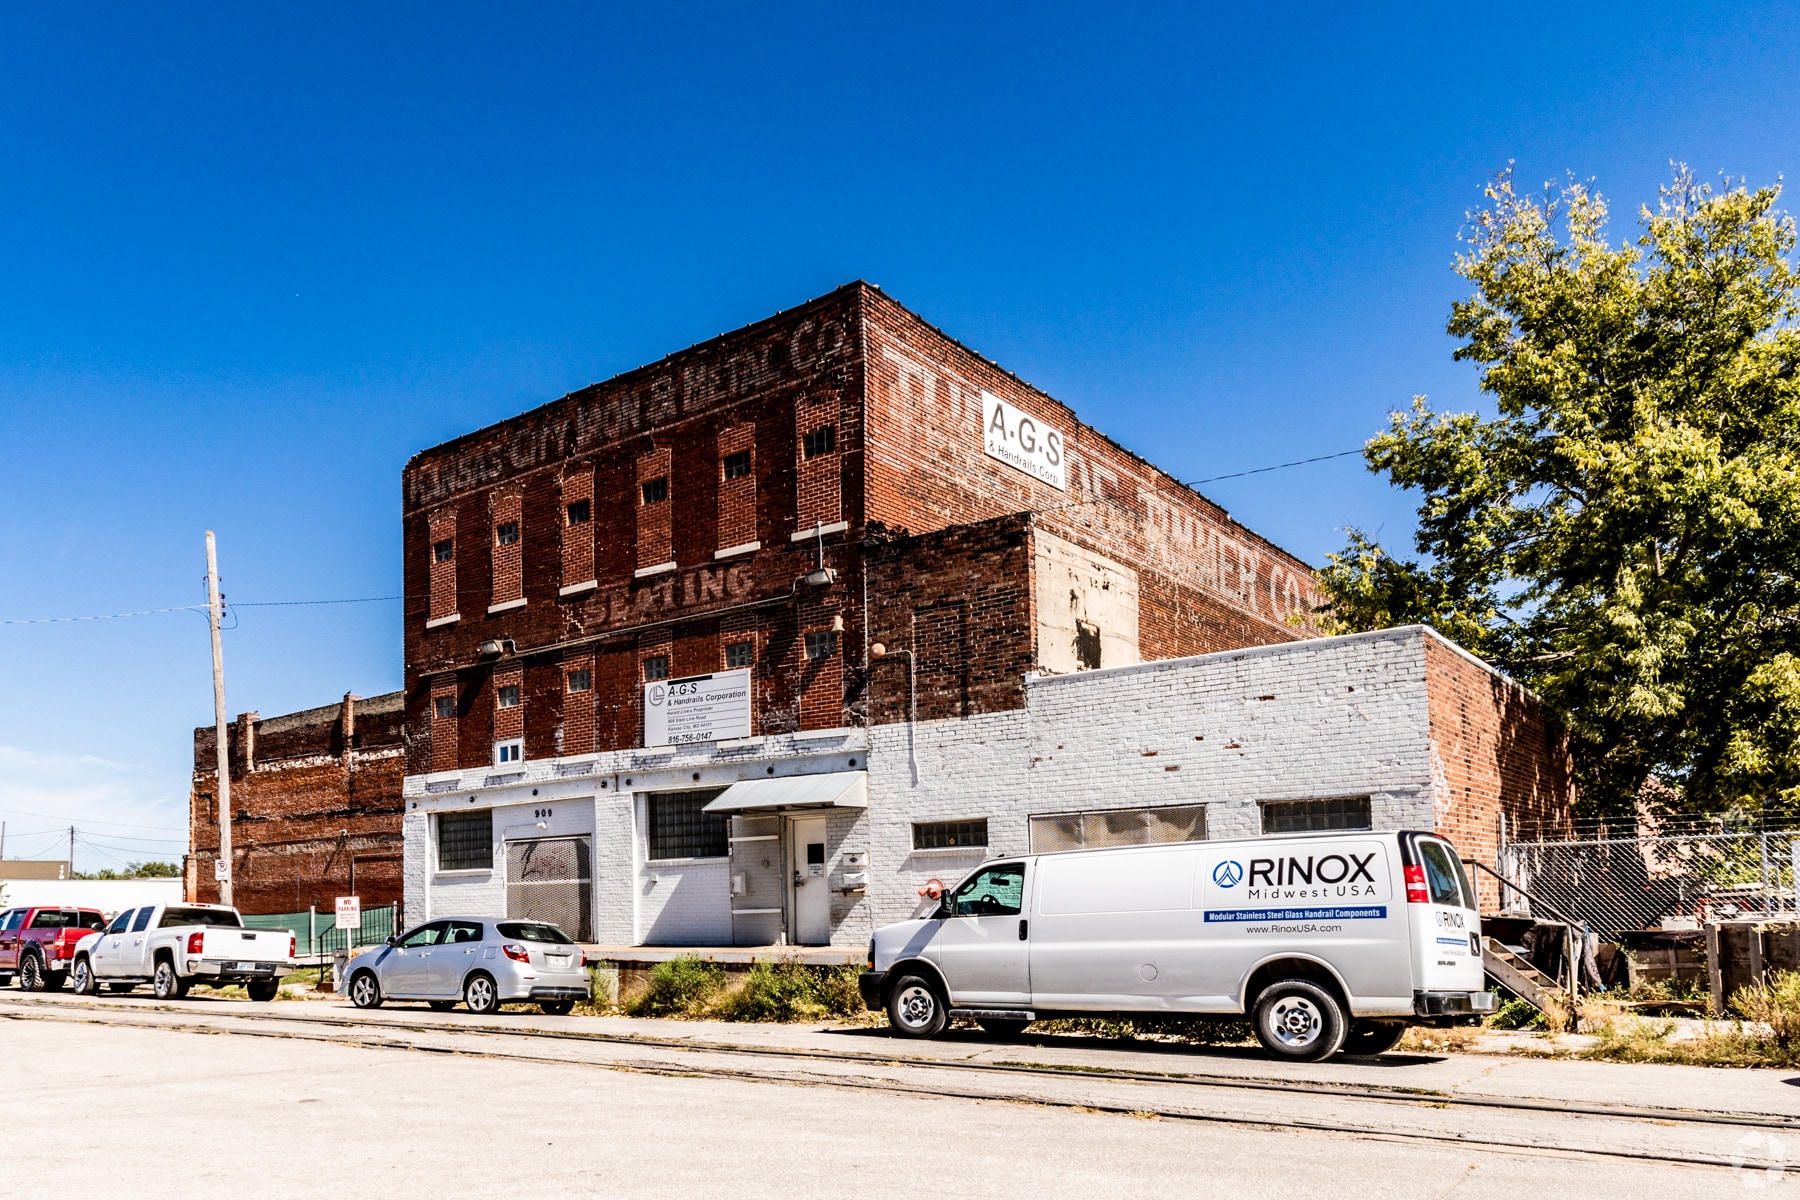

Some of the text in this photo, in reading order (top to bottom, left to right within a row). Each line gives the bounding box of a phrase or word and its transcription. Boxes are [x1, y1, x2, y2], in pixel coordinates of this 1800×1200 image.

[998, 444, 1037, 474] Handrails
[673, 696, 703, 706] Handrails
[706, 690, 746, 702] Corporation
[534, 808, 552, 818] 909
[1249, 853, 1376, 887] RINOX
[1248, 885, 1376, 900] Midwest USA
[1209, 908, 1380, 921] Modular Stainless Steel Glass Handrail Components
[1443, 911, 1465, 928] RINOX
[1246, 925, 1342, 934] www.RinoxUSA.com
